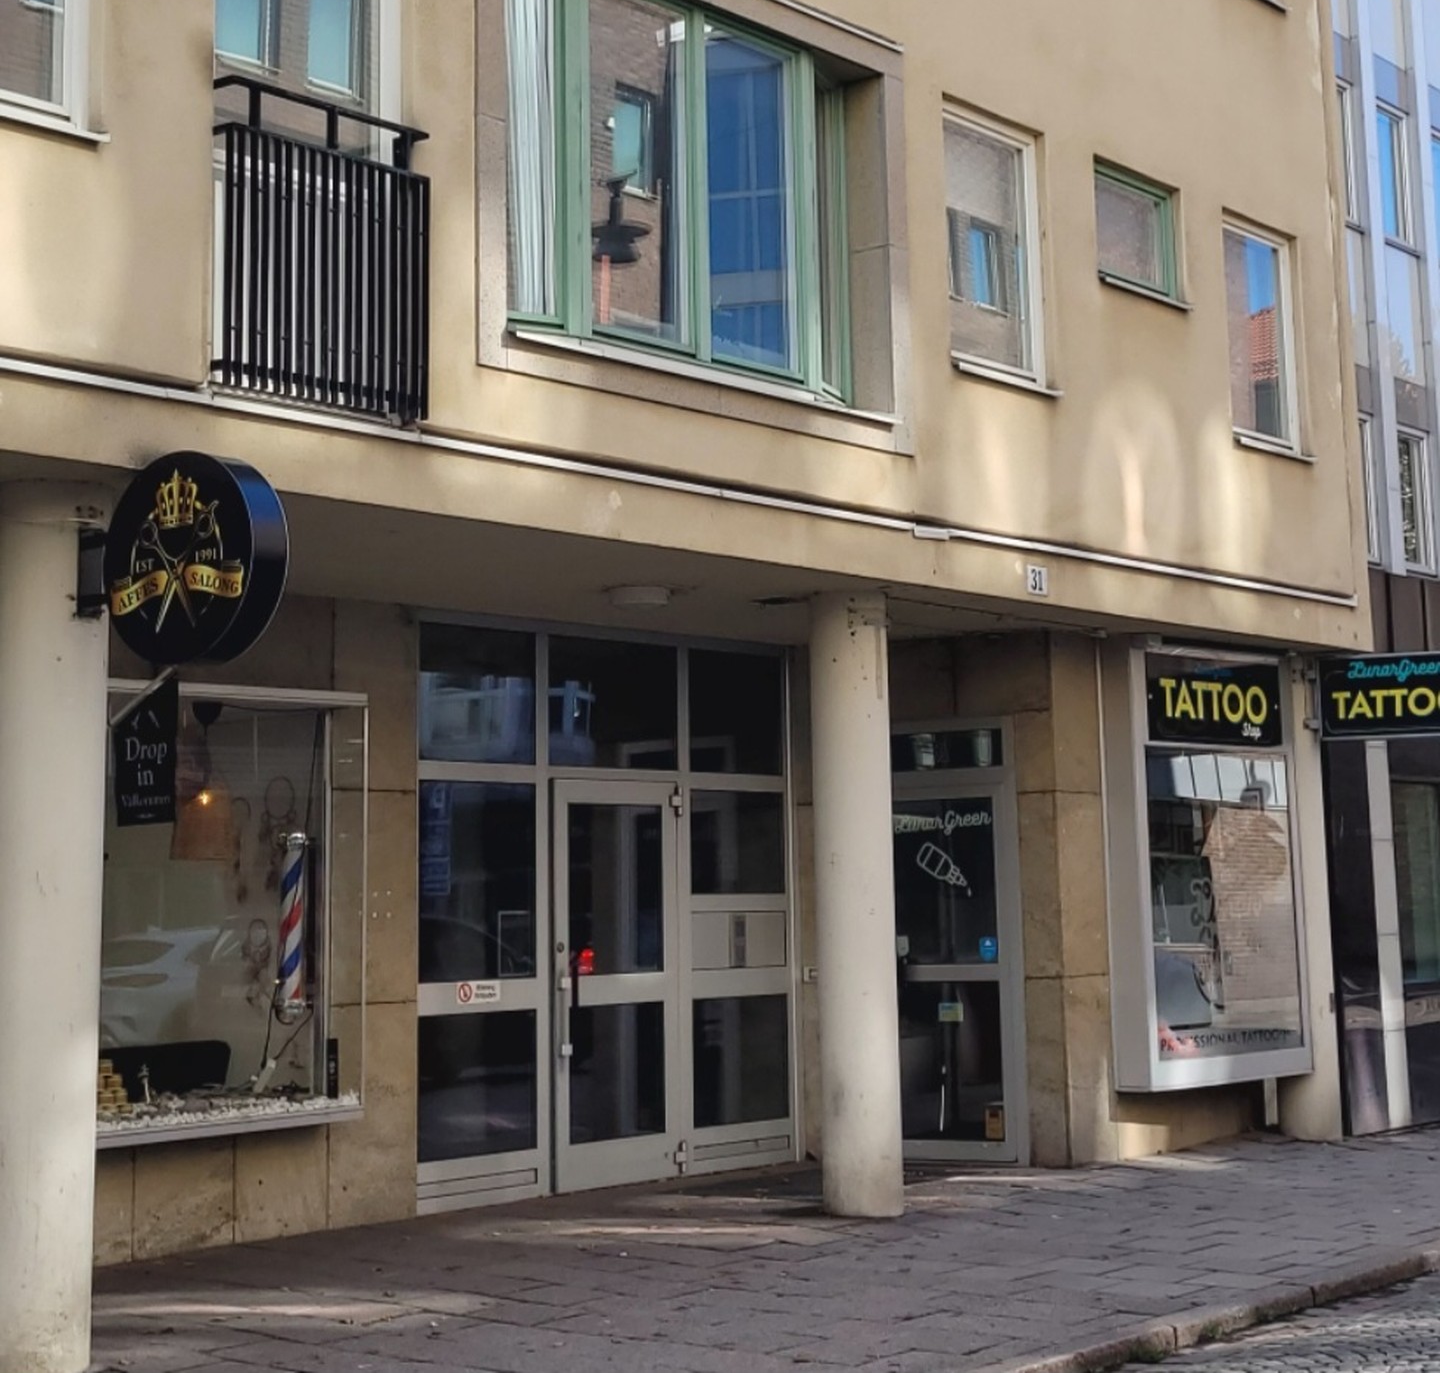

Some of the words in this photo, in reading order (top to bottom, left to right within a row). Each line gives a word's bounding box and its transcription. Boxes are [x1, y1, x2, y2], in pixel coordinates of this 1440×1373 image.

[136, 558, 155, 574] EST
[195, 547, 217, 563] 1991
[190, 571, 240, 595] SALONG
[1030, 568, 1043, 591] 31
[1347, 659, 1440, 682] LunarGree
[1160, 677, 1268, 725] TATTOO
[1332, 687, 1440, 720] TATTO
[1241, 722, 1262, 741] Shop
[125, 736, 168, 764] Drop
[137, 763, 154, 786] in
